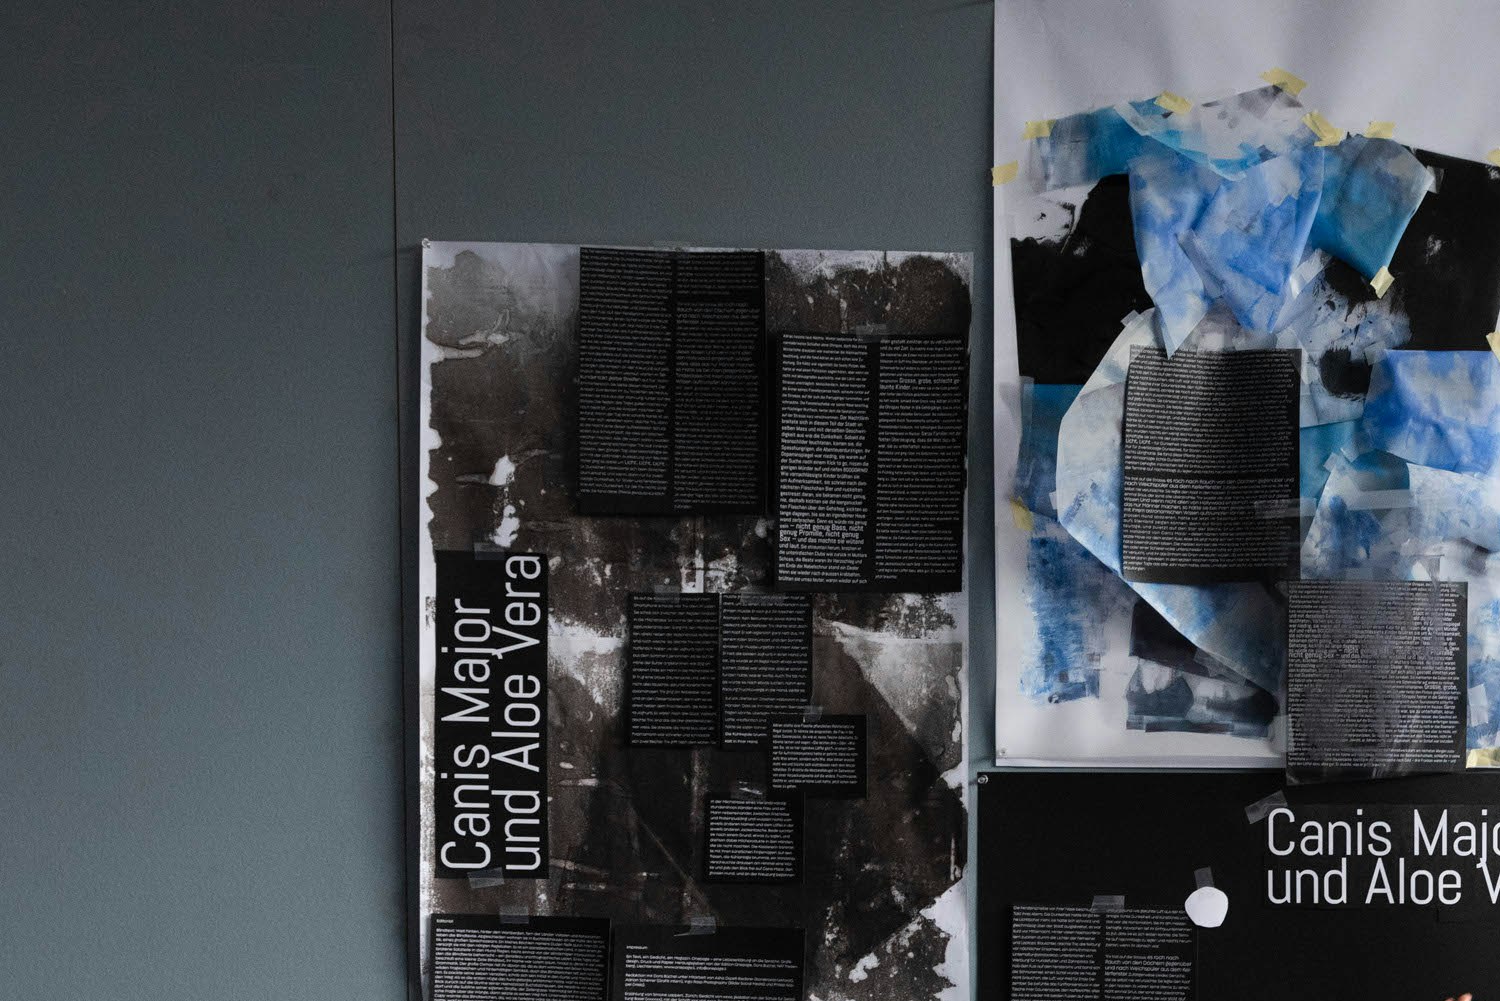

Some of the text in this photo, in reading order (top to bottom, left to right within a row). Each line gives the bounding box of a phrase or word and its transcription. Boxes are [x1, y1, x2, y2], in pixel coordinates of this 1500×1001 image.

[441, 598, 503, 870] Canis Major
[491, 555, 541, 871] und Aloe Vera
[1268, 808, 1392, 856] Canis
[1268, 858, 1347, 904] und
[1365, 858, 1462, 904] Aloe
